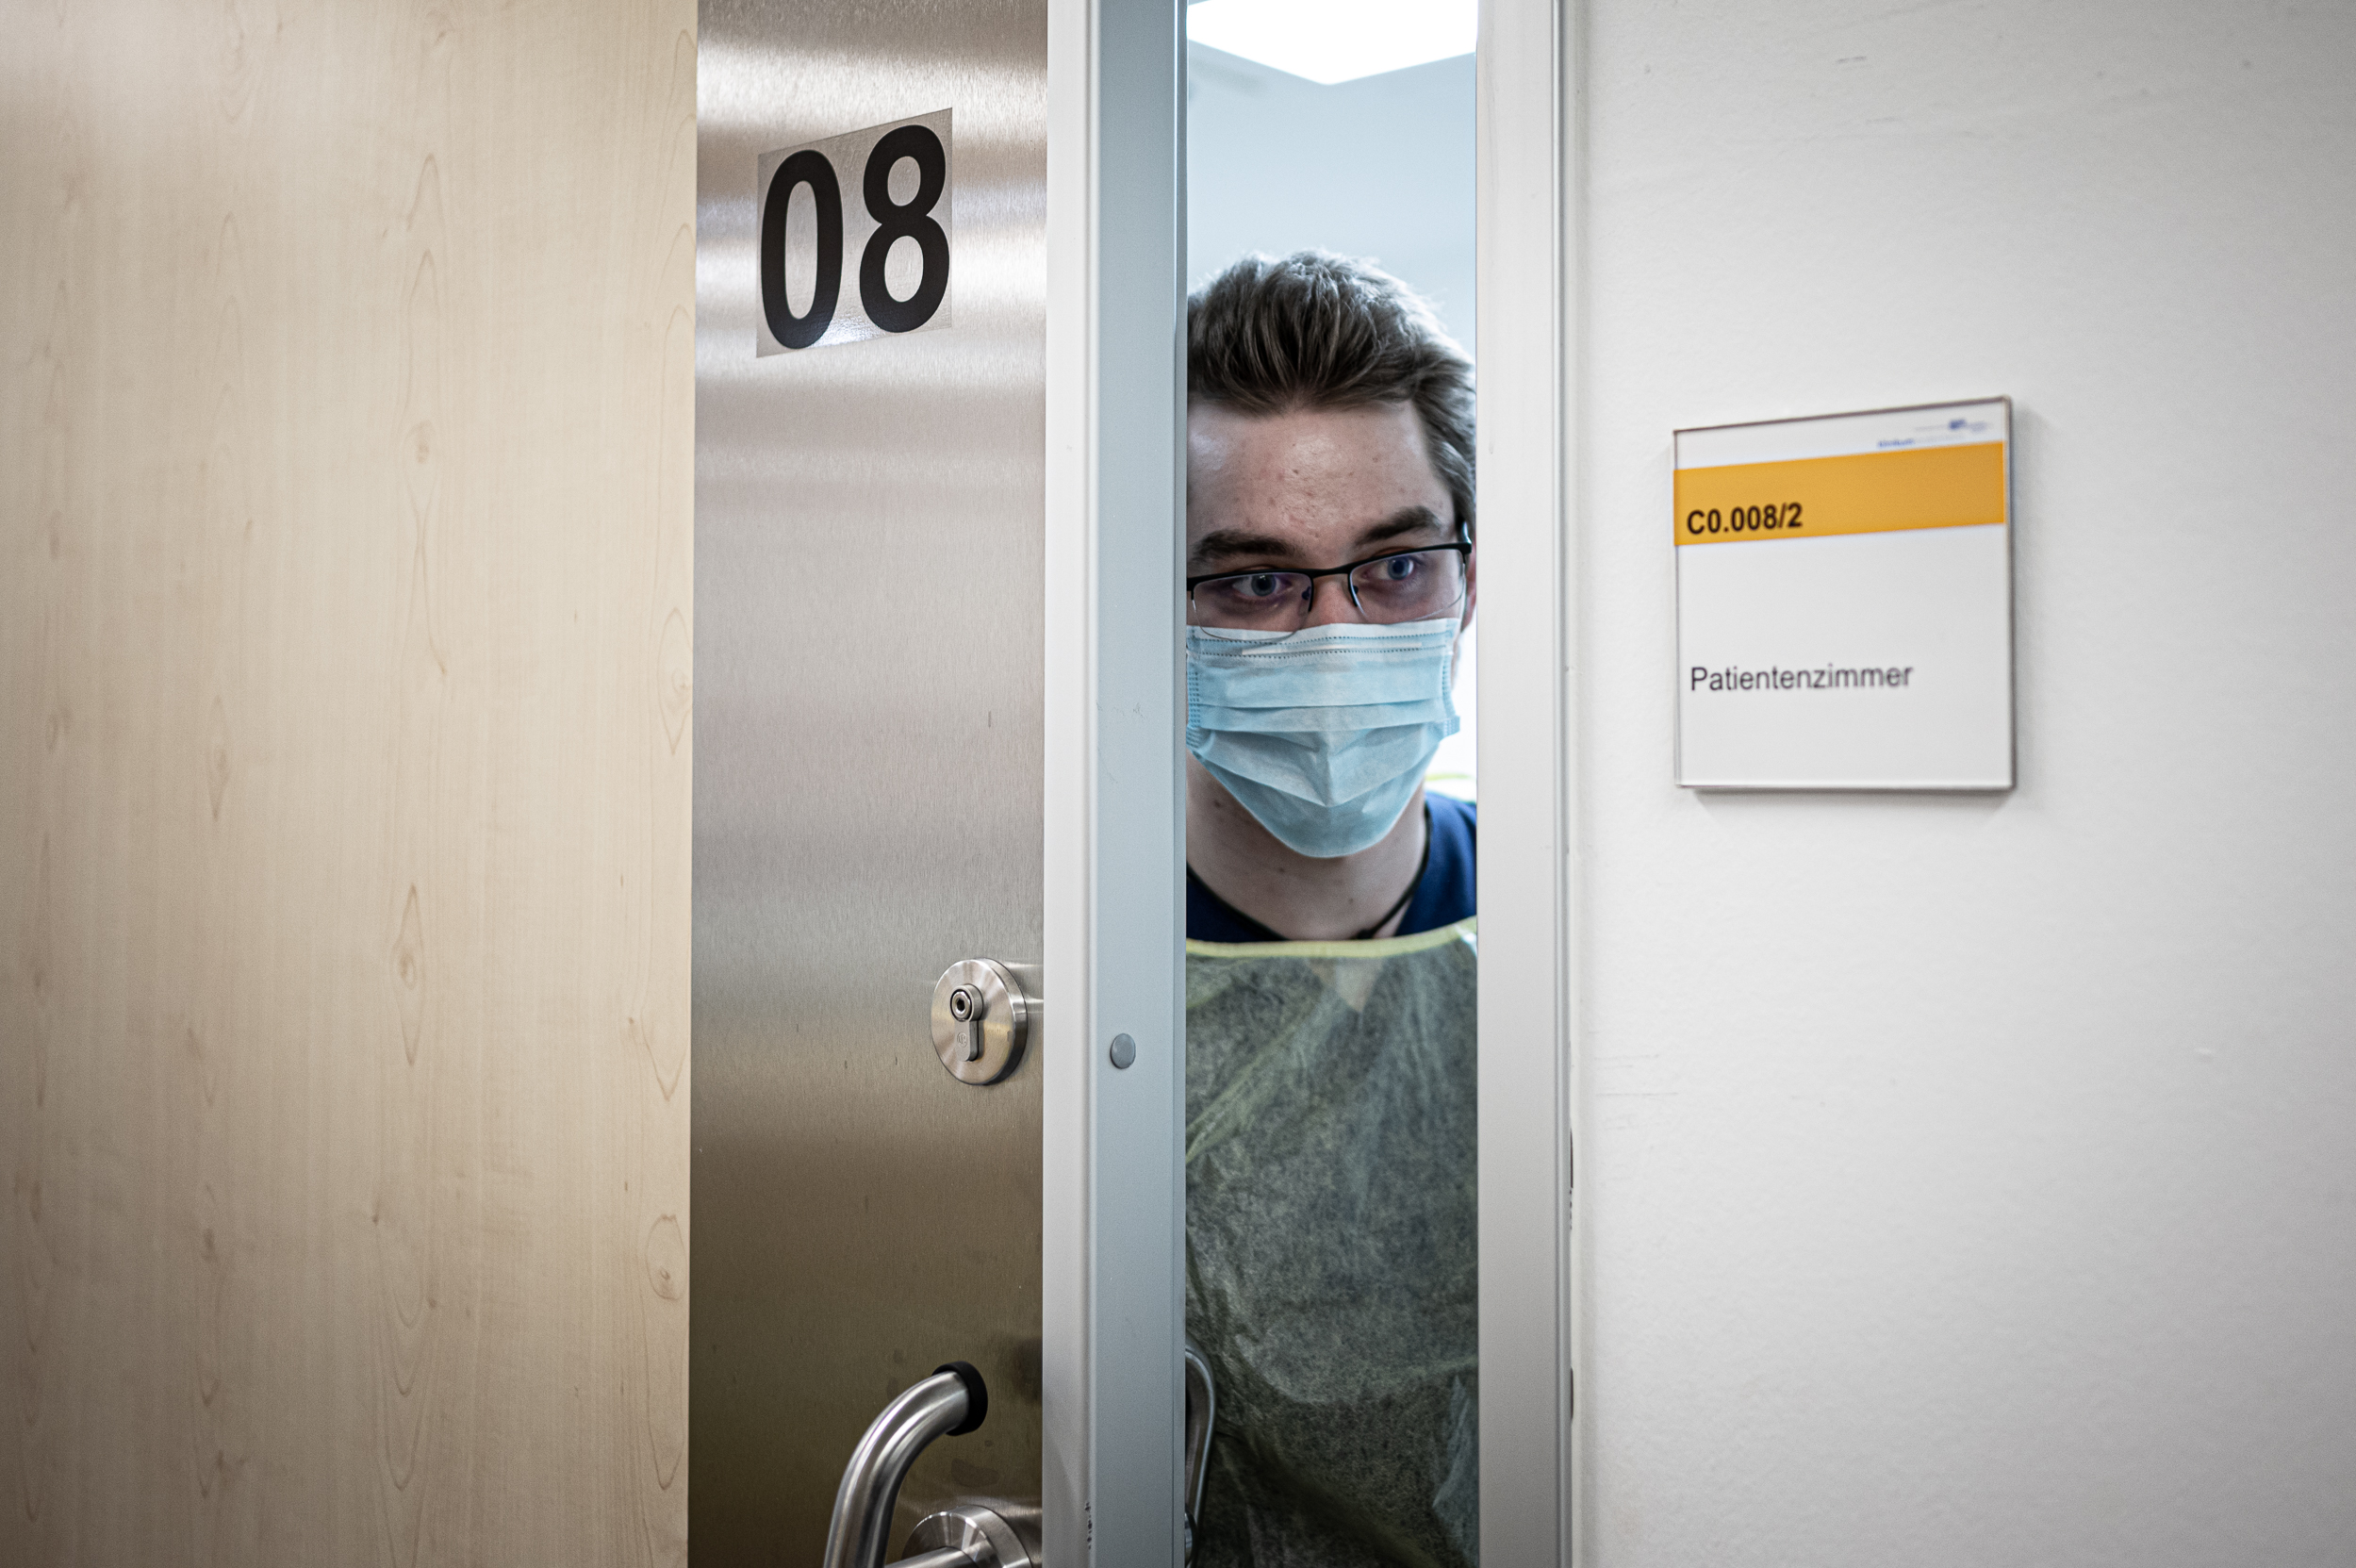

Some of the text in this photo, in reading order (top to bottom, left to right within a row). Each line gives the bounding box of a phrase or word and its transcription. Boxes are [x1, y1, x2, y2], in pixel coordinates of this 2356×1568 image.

[761, 124, 950, 350] 08
[1687, 502, 1804, 536] C0.008/2
[1689, 663, 1914, 692] Patientenzimmer
